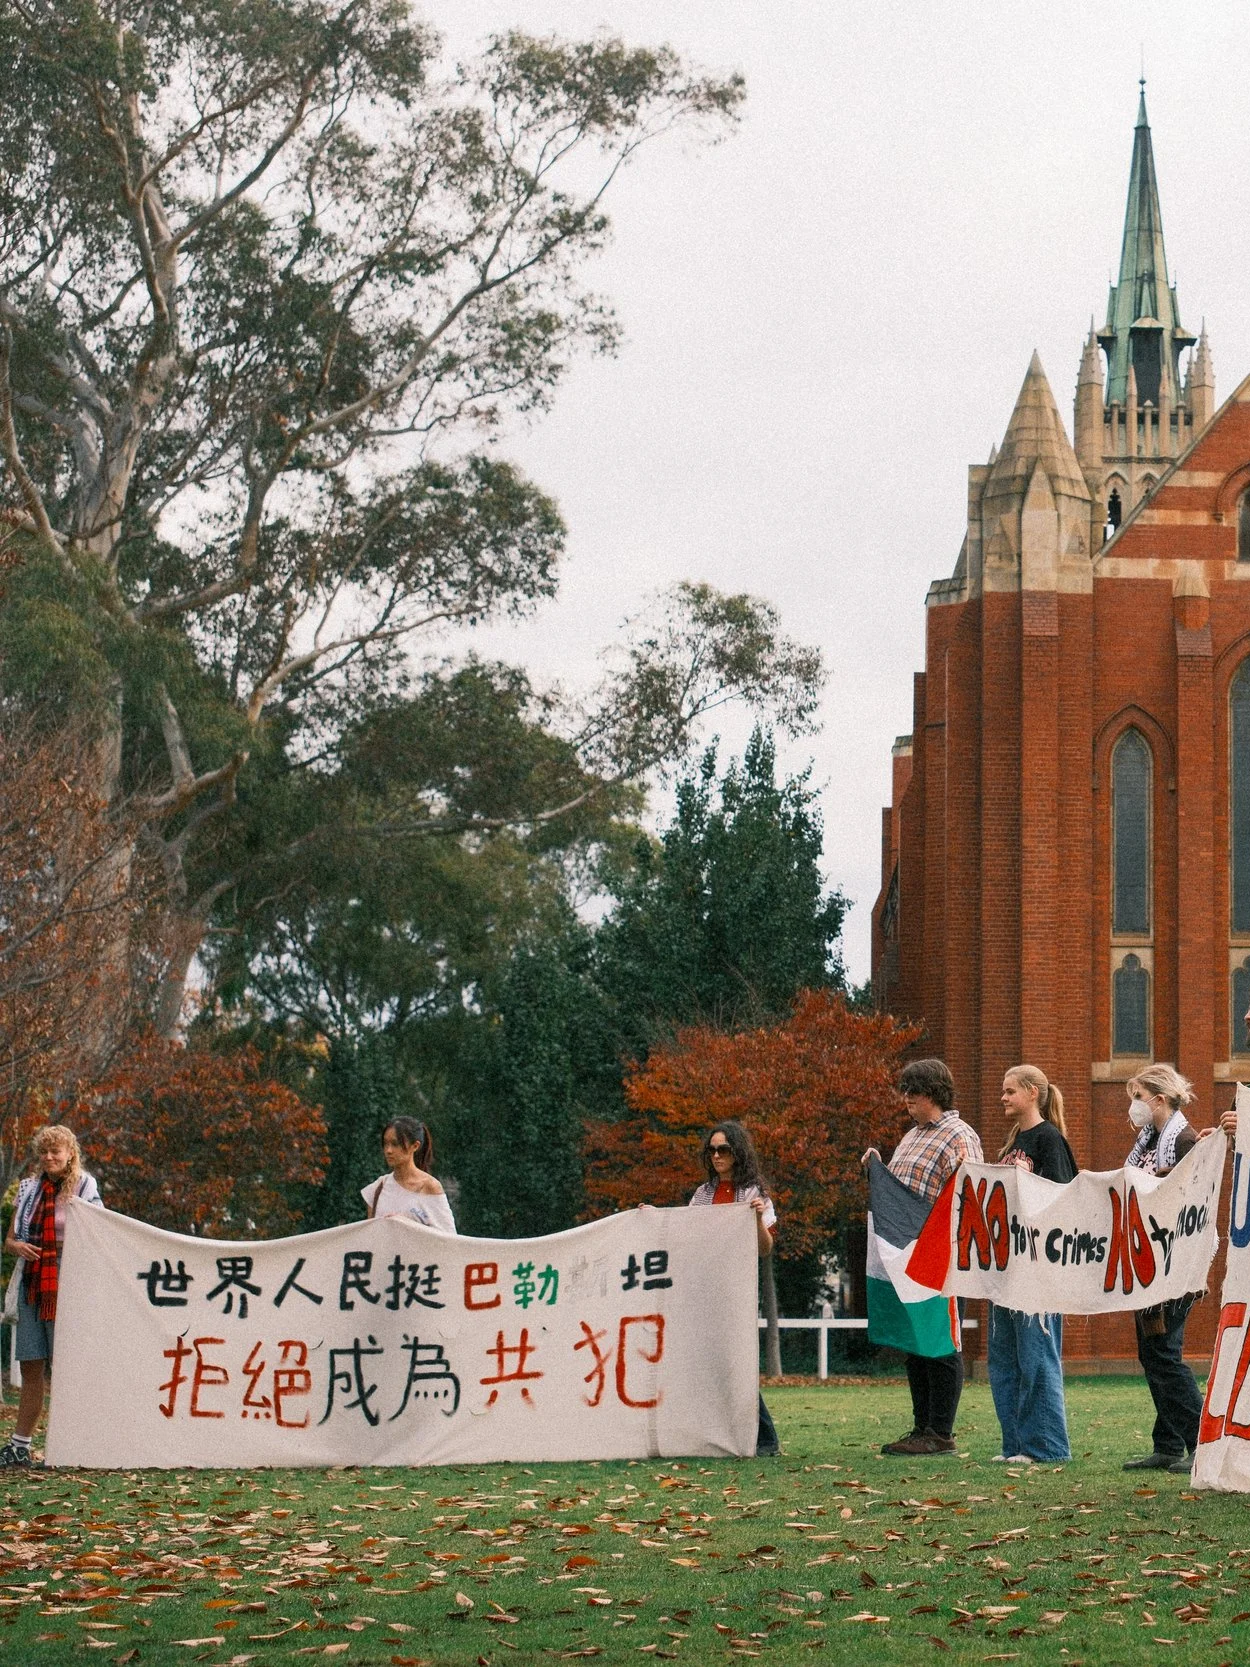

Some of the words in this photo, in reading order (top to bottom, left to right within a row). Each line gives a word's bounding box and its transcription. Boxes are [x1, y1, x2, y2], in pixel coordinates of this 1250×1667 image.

[957, 1173, 1010, 1272] NO
[1103, 1178, 1157, 1296] NO
[157, 1312, 665, 1429] 拒絕成為共犯
